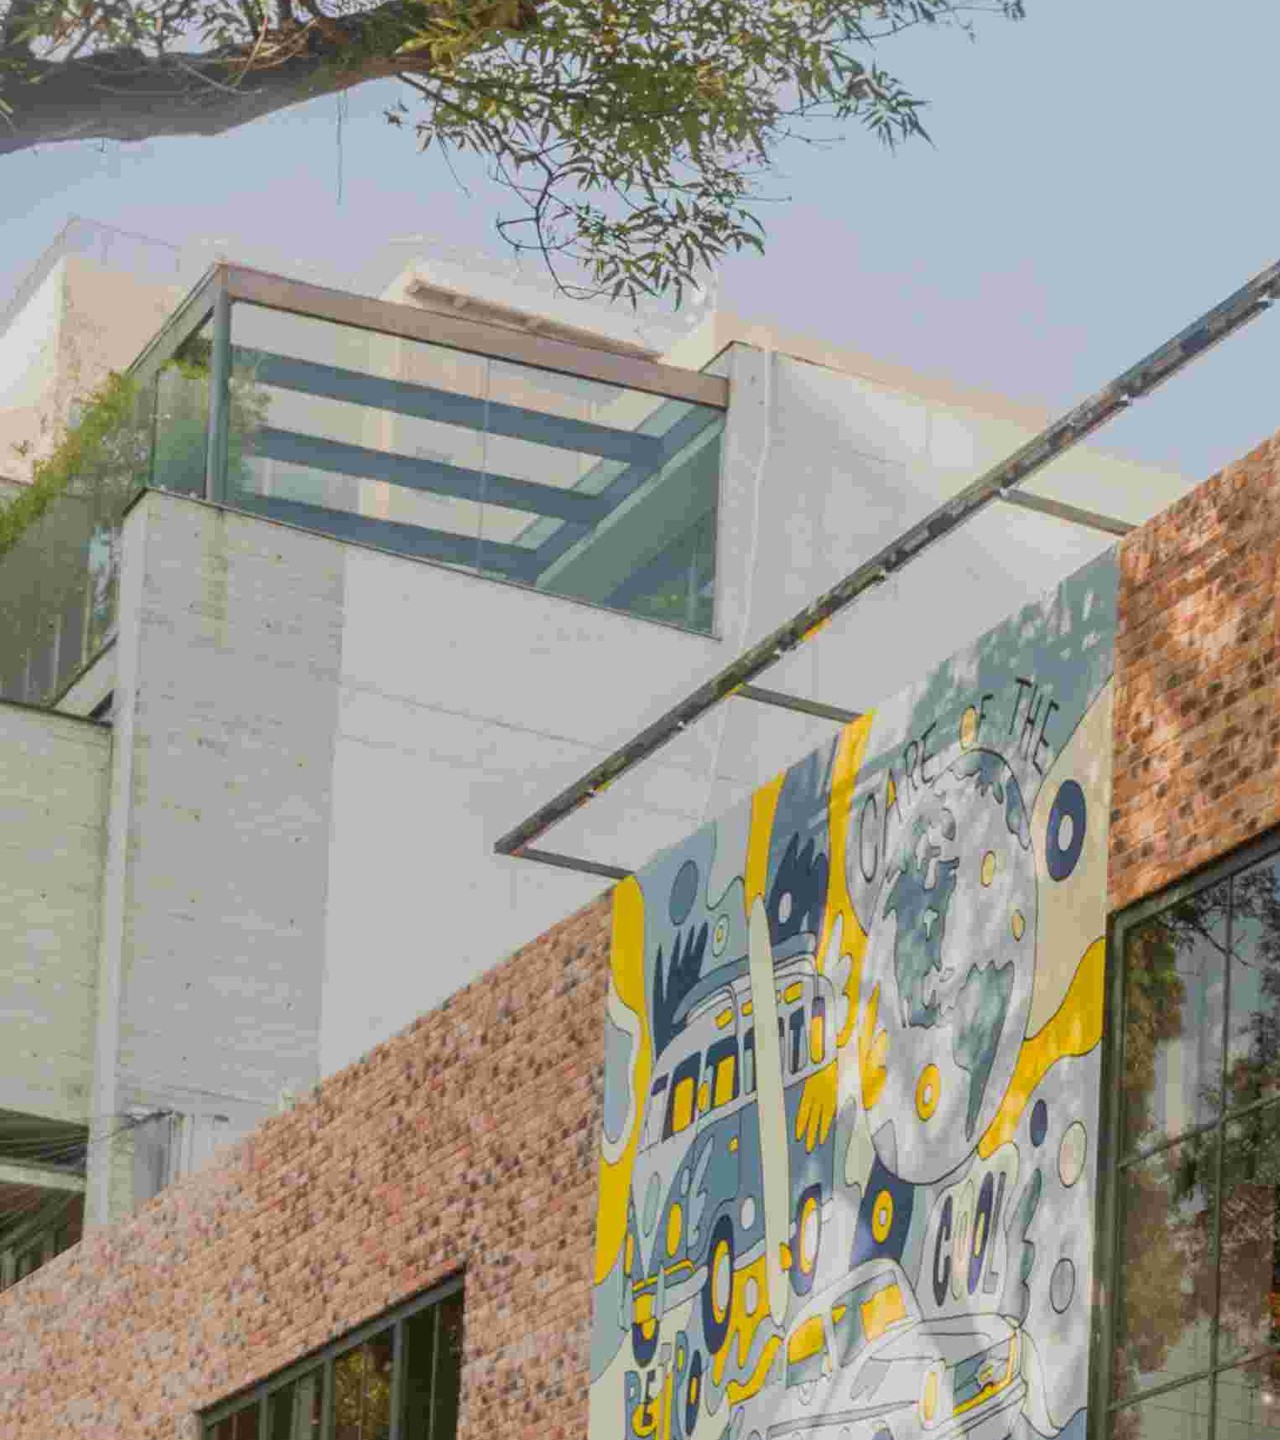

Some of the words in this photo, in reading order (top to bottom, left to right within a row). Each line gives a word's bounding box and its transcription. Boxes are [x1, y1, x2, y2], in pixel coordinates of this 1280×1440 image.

[959, 693, 994, 751] OF
[1008, 676, 1060, 776] THE
[932, 1170, 1007, 1308] COOL
